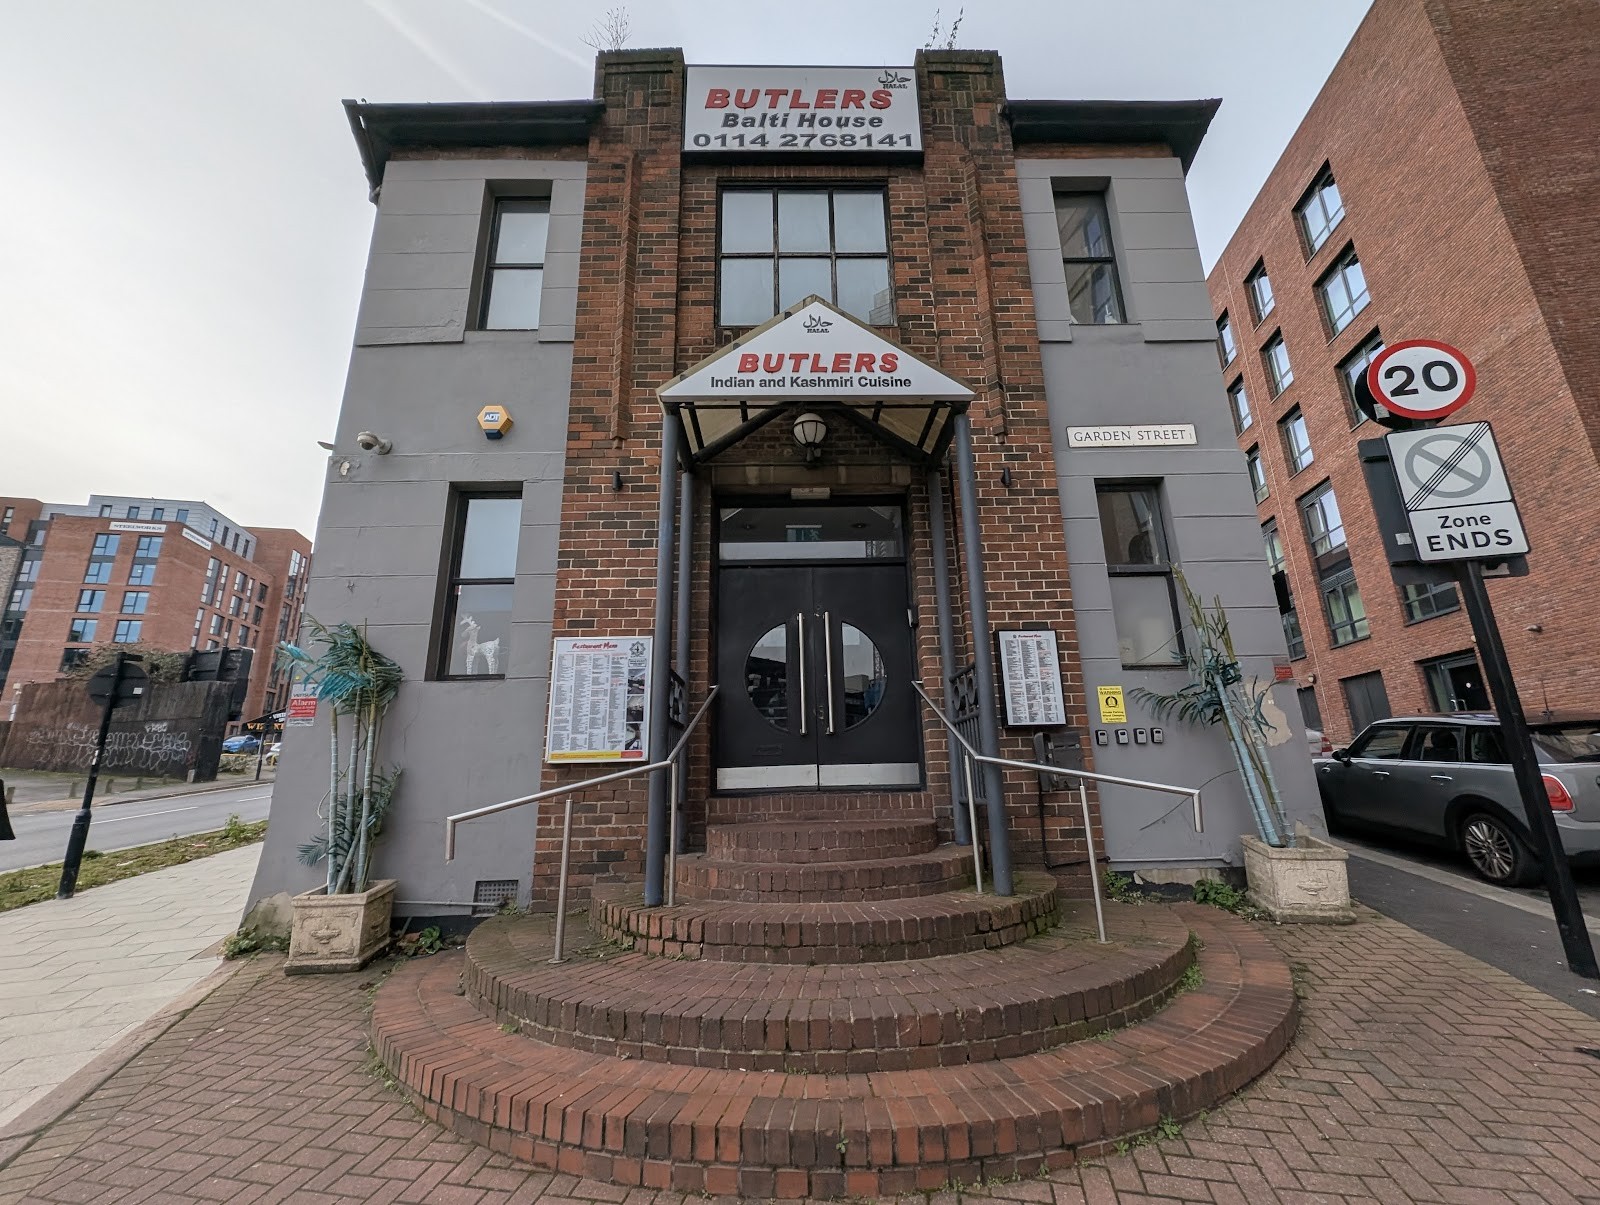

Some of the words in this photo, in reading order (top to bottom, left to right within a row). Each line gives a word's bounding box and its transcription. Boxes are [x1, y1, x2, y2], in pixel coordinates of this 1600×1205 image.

[705, 88, 893, 110] BUTLERS
[721, 112, 790, 128] Balti
[797, 112, 884, 128] House
[693, 133, 769, 147] 0114
[779, 133, 912, 148] 2768141
[737, 353, 899, 374] BUTLERS
[710, 376, 755, 388] Indian
[758, 376, 787, 388] and
[790, 376, 854, 388] Kashmiri
[857, 376, 912, 388] Cuisine
[1384, 360, 1459, 397] 20
[484, 412, 500, 421] ADT
[1074, 431, 1131, 442] GARDEN
[1137, 429, 1186, 440] STREET
[1437, 515, 1492, 529] Zone
[1426, 529, 1513, 552] ENDS
